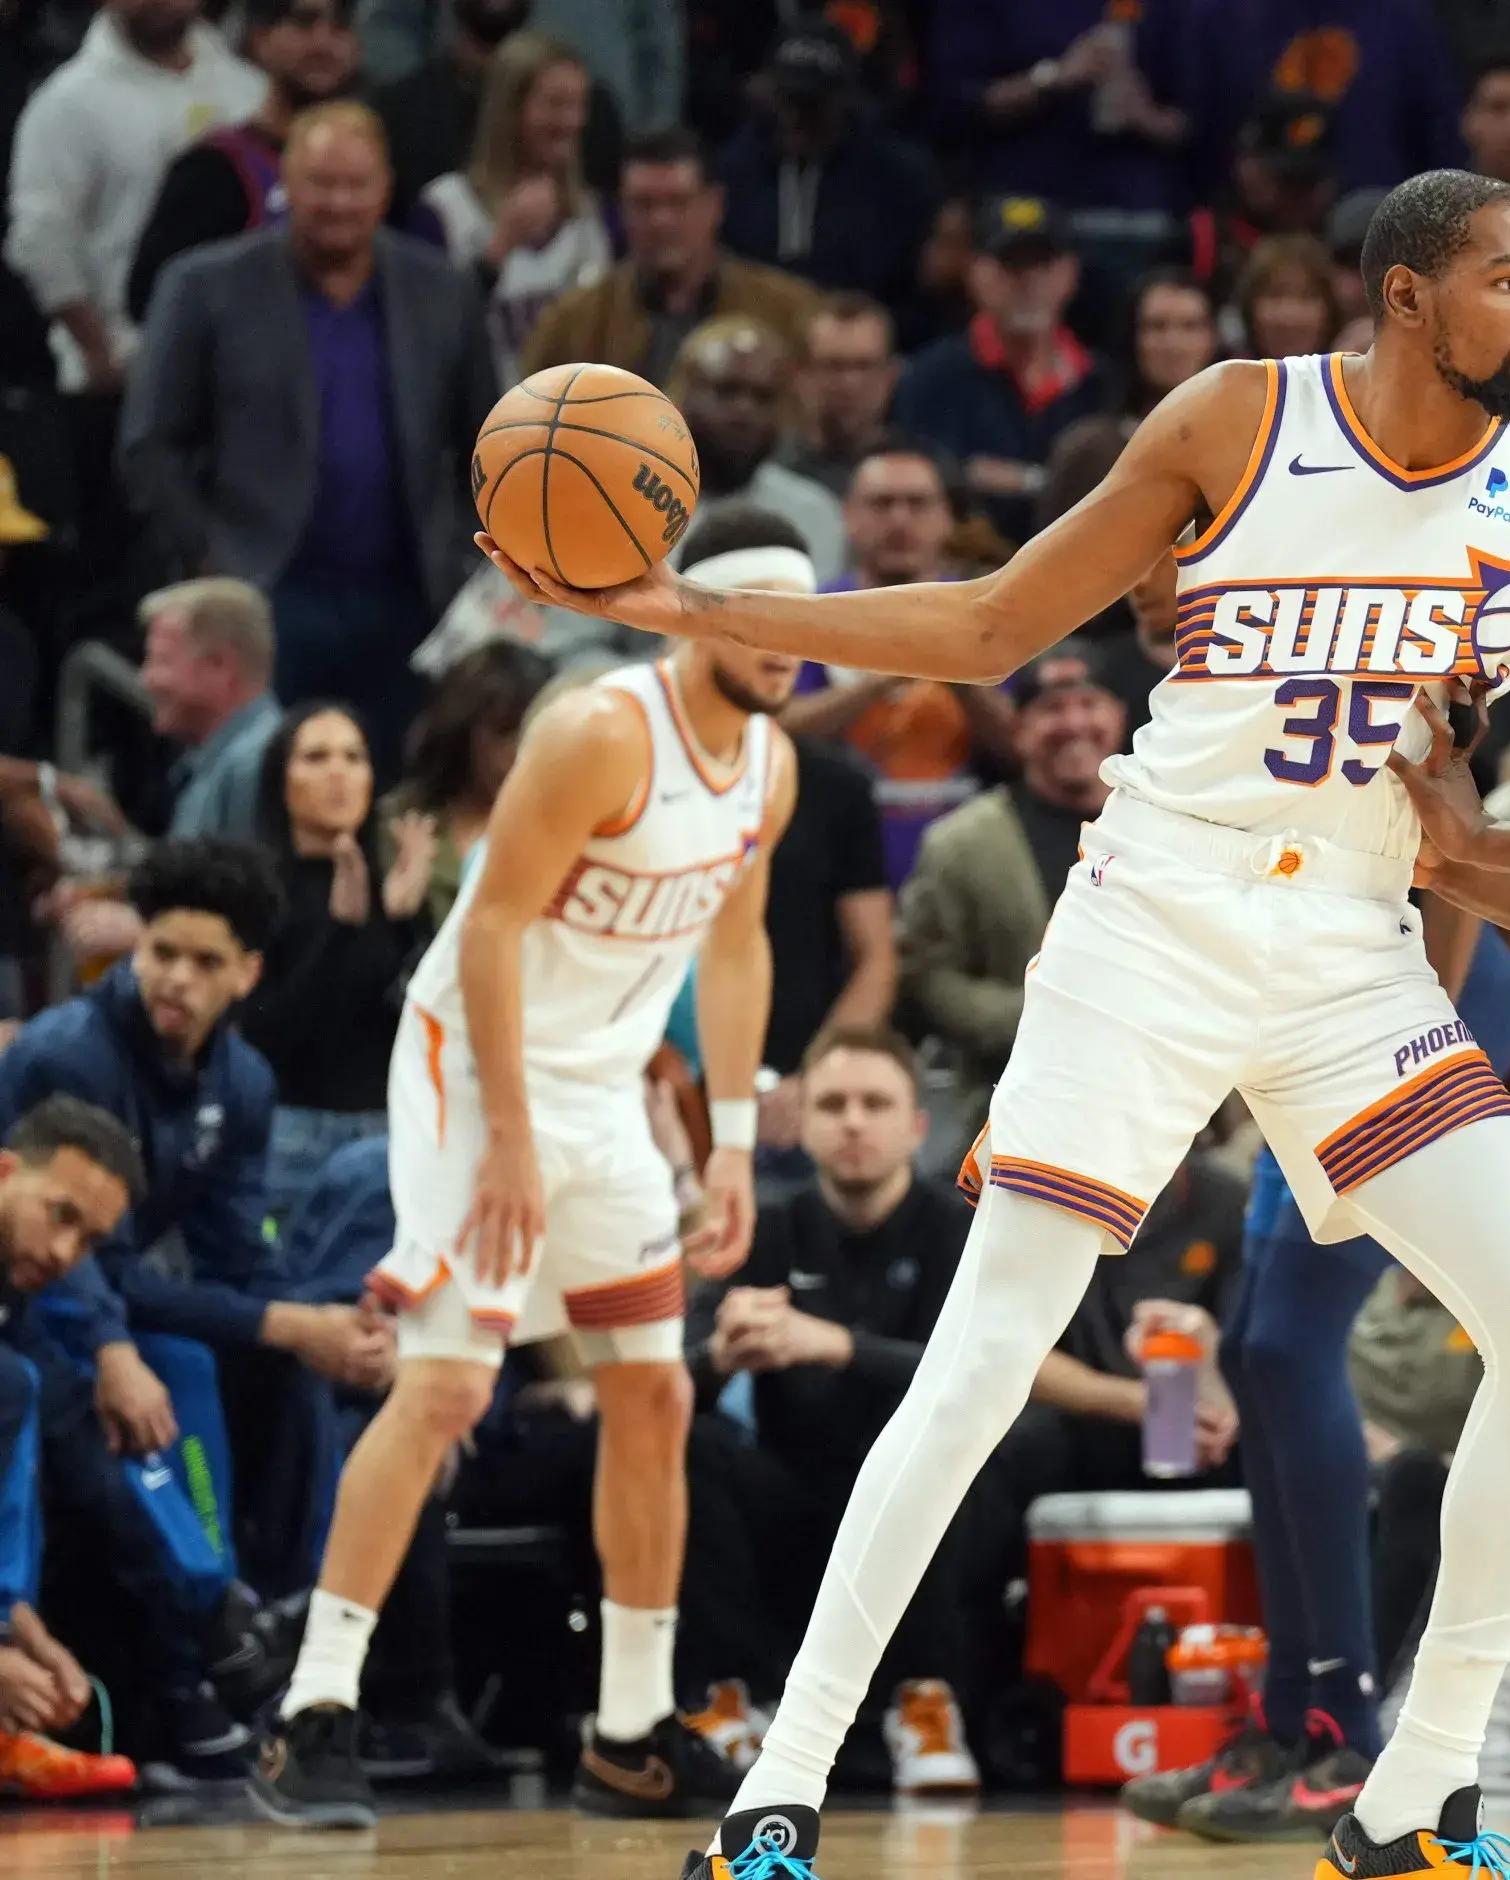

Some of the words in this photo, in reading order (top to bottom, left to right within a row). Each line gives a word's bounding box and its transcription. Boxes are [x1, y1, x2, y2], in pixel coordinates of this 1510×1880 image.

[1204, 587, 1467, 675] SUNS
[1263, 678, 1416, 788] 35
[1114, 1719, 1158, 1775] G
